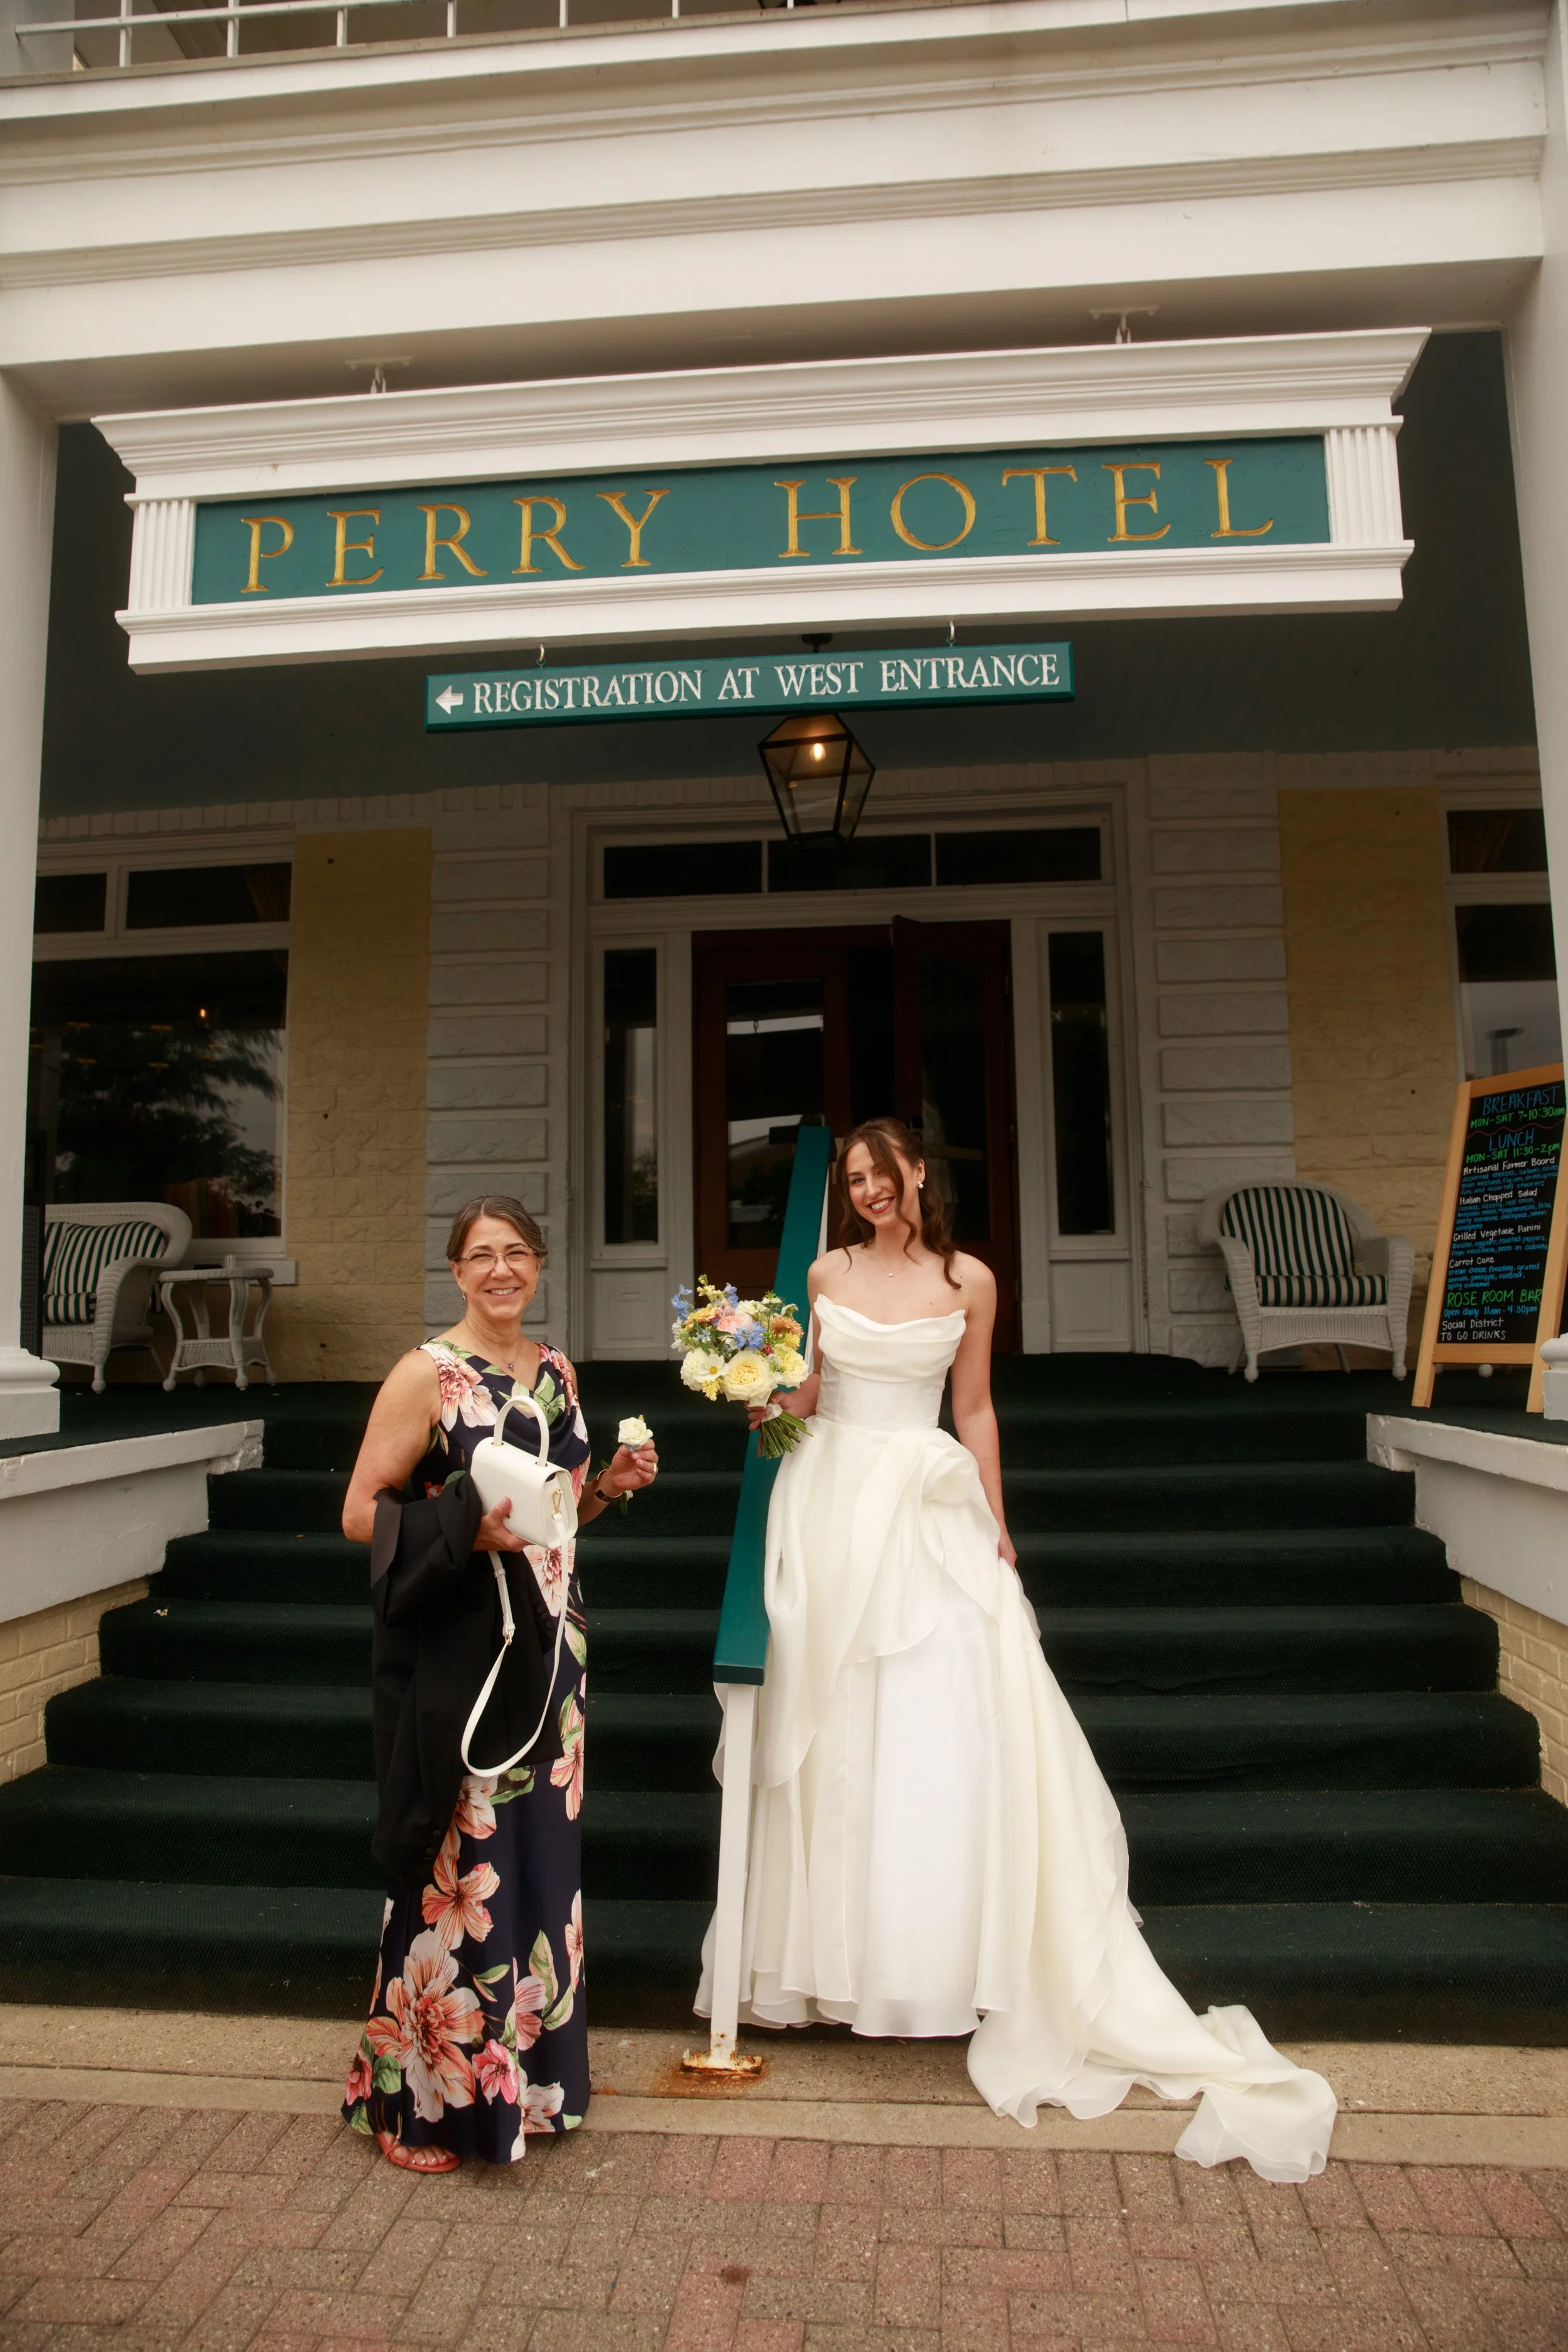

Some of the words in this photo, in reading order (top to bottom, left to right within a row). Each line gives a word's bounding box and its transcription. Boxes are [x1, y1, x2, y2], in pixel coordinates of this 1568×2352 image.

[240, 489, 671, 593] PERRY
[773, 458, 1274, 559] HOTEL
[472, 669, 702, 714] REGISTRATION
[718, 667, 760, 700] AT
[773, 662, 864, 697] WEST
[879, 654, 1060, 692] ENTRANCE
[1483, 1086, 1560, 1116] BREAKFAST
[1470, 1113, 1514, 1128] MON-SAT
[1489, 1129, 1535, 1151] LUNCH
[1466, 1150, 1508, 1163] MON-SAT
[1463, 1163, 1499, 1175] Artisanal
[1503, 1161, 1528, 1171] Farmer
[1531, 1157, 1555, 1167] Board
[1459, 1196, 1481, 1205] Italian
[1483, 1191, 1513, 1202] Chopped
[1518, 1189, 1538, 1197] Salad
[1453, 1231, 1476, 1242] Grilled
[1480, 1227, 1514, 1240] Vegetable
[1518, 1222, 1541, 1233] Panini
[1449, 1258, 1474, 1268] Carrot
[1476, 1256, 1495, 1264] Cake
[1447, 1292, 1478, 1308] ROSE
[1481, 1290, 1514, 1305] ROOM
[1520, 1289, 1542, 1305] BAR
[1444, 1309, 1459, 1318] Open
[1463, 1308, 1480, 1318] daily
[1442, 1320, 1466, 1331] Social
[1470, 1318, 1504, 1328] District
[1441, 1332, 1451, 1342] TO
[1457, 1332, 1468, 1340] GO
[1472, 1331, 1506, 1340] DRINKS
